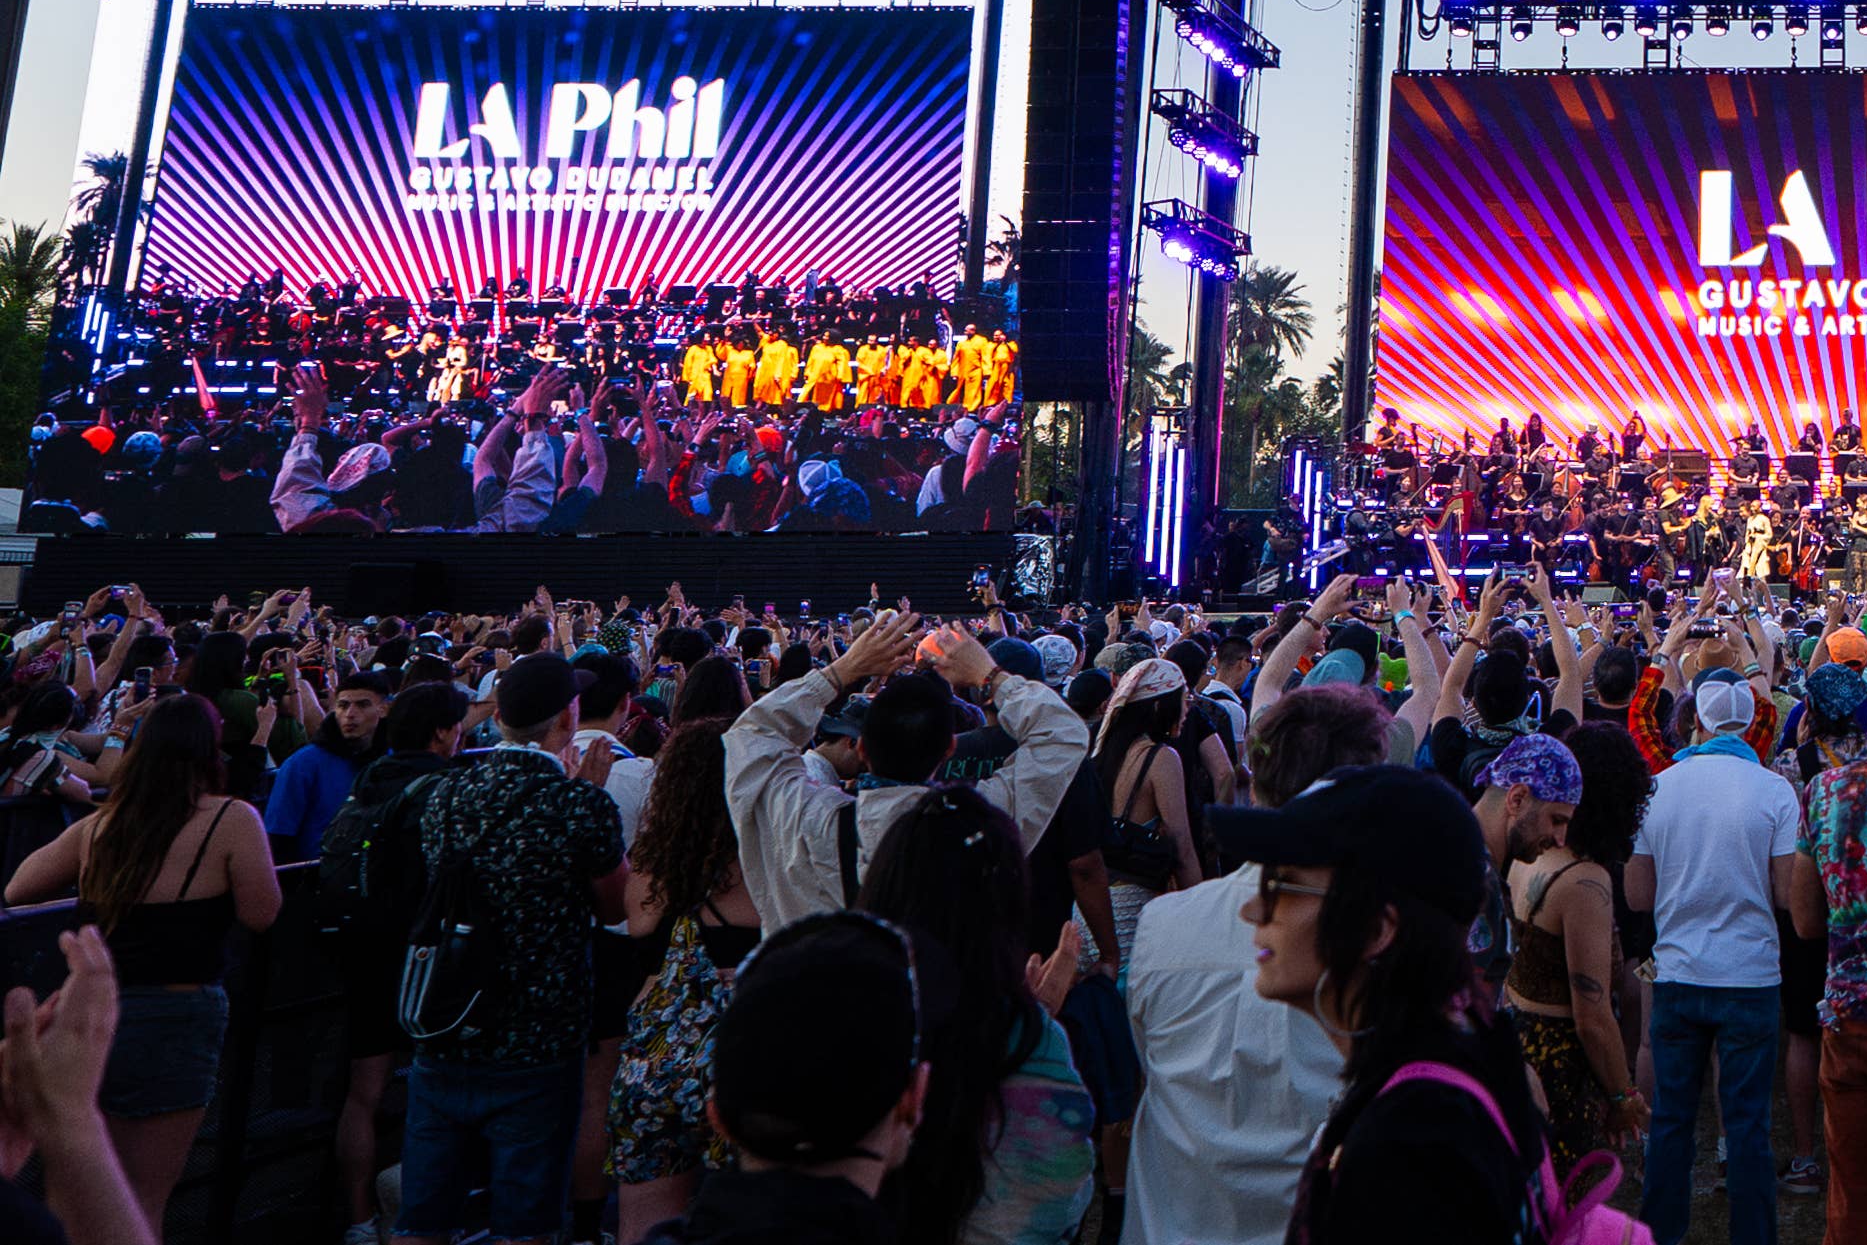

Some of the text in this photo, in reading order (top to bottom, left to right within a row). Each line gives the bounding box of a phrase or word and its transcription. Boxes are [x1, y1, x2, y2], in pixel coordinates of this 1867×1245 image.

[414, 75, 725, 158] LA Phil
[408, 166, 714, 190] GUSTAVO DUDAMEL
[1699, 169, 1836, 266] LA
[1698, 314, 1782, 337] MUSIC
[1793, 315, 1810, 336] &
